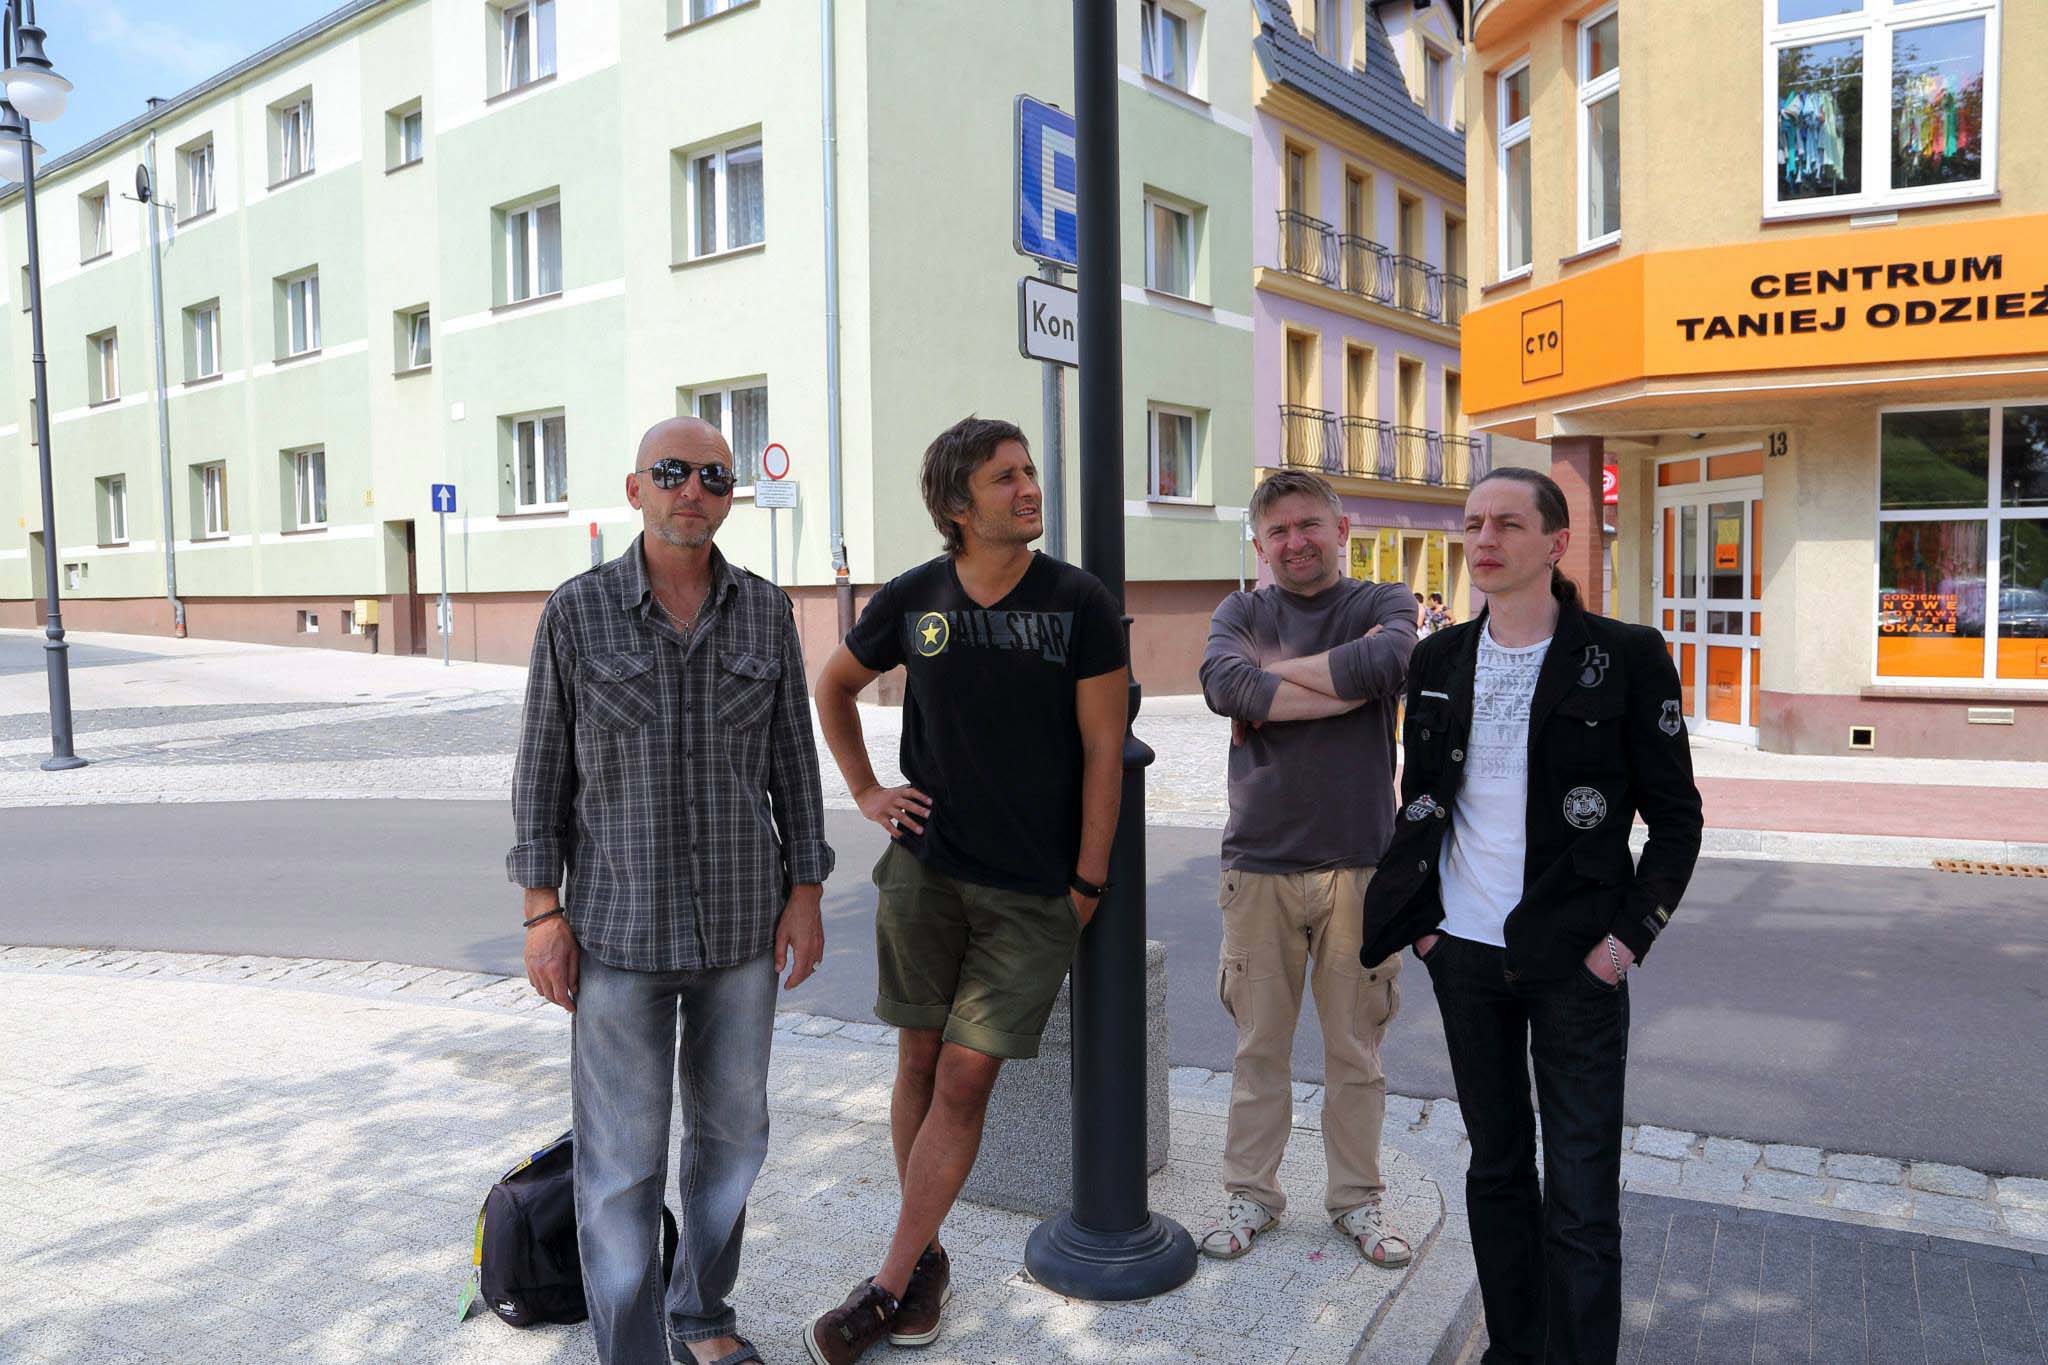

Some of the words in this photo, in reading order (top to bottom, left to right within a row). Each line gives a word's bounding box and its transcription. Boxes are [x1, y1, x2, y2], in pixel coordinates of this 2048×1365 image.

[1750, 254, 2003, 299] CENTRUM
[1033, 299, 1075, 342] Kon
[1676, 306, 1846, 342] TANIEJ
[1526, 330, 1558, 354] CTO
[1768, 431, 1788, 457] 13
[1883, 601, 1957, 610] NOWE
[1006, 611, 1069, 658] STAR
[1882, 623, 1957, 633] OKAZJE
